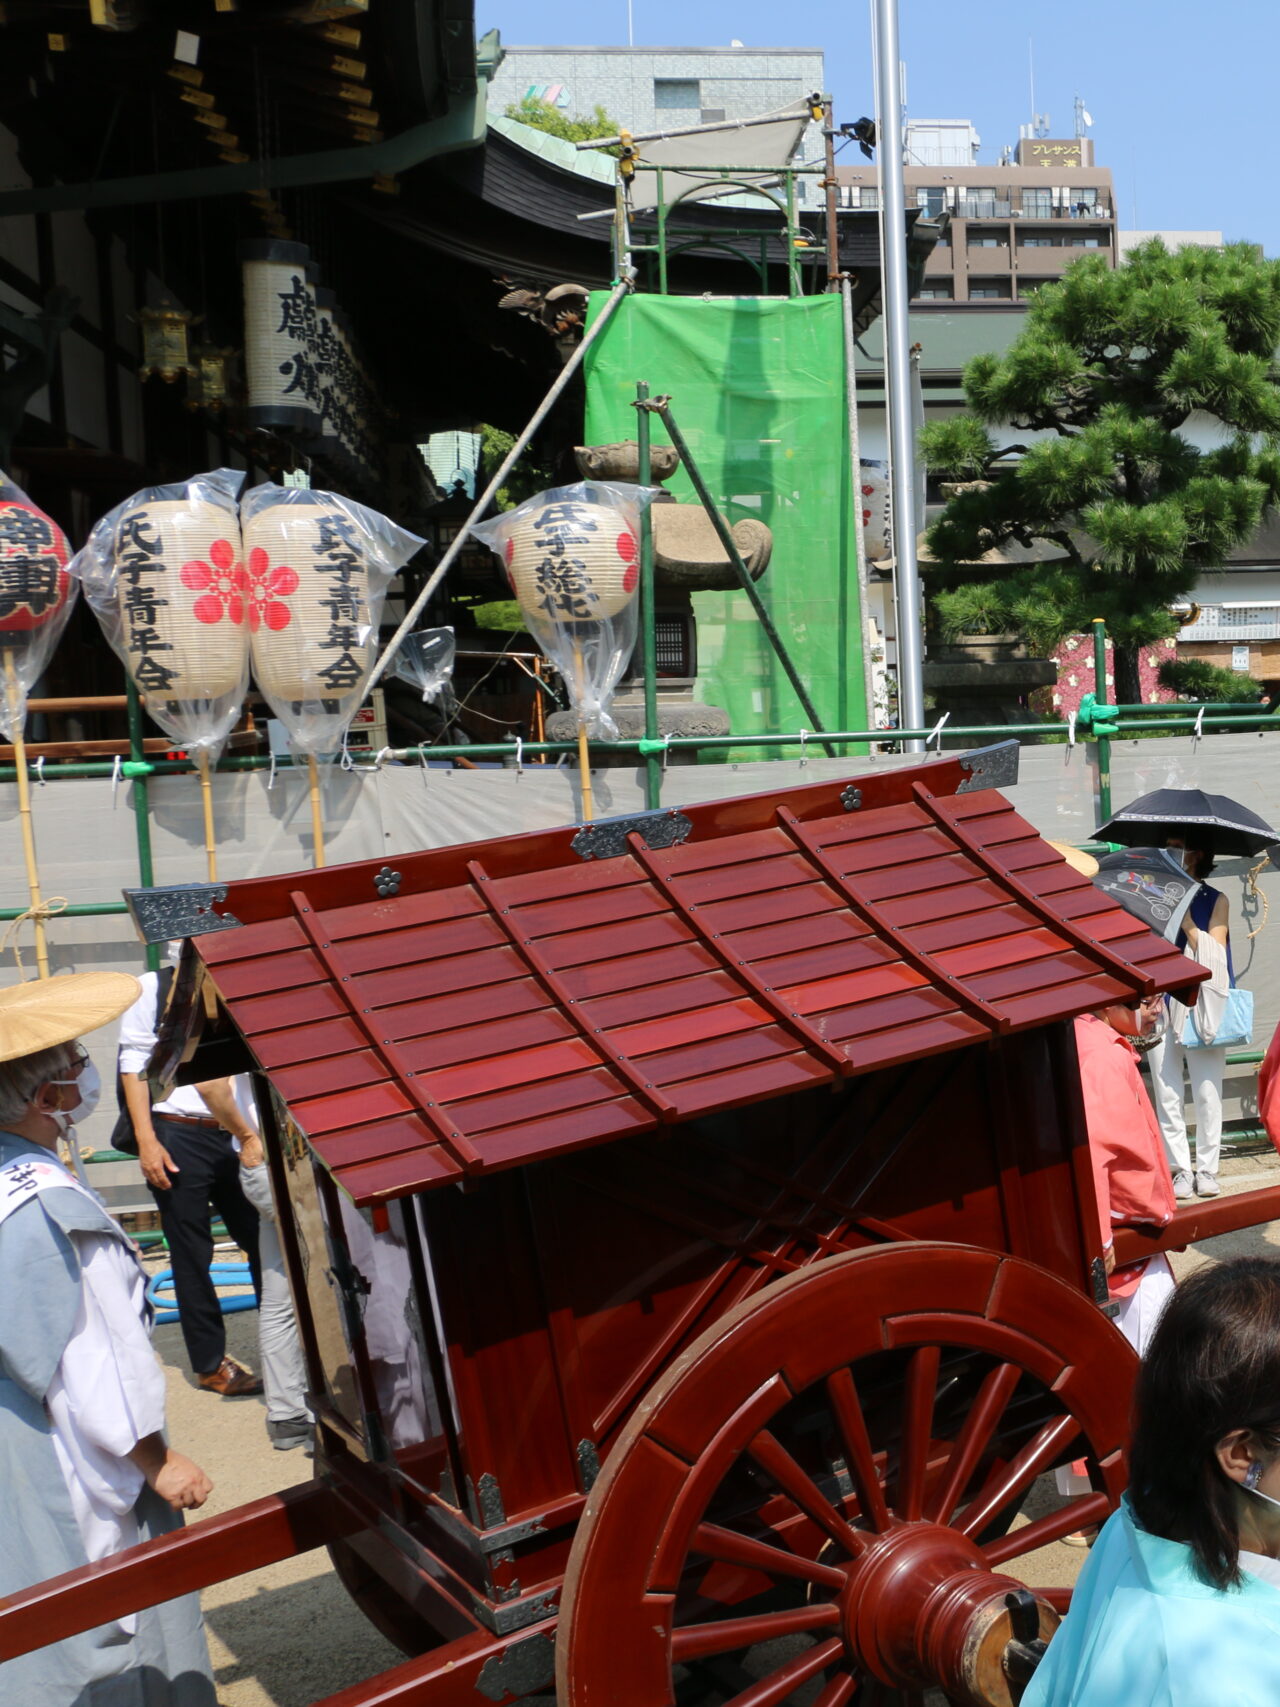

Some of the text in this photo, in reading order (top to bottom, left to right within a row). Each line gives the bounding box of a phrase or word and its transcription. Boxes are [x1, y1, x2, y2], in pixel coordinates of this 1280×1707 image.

[1032, 145, 1081, 155] プレサンス
[118, 511, 180, 691] 氏子青年会
[311, 515, 364, 690] 氏子青年会
